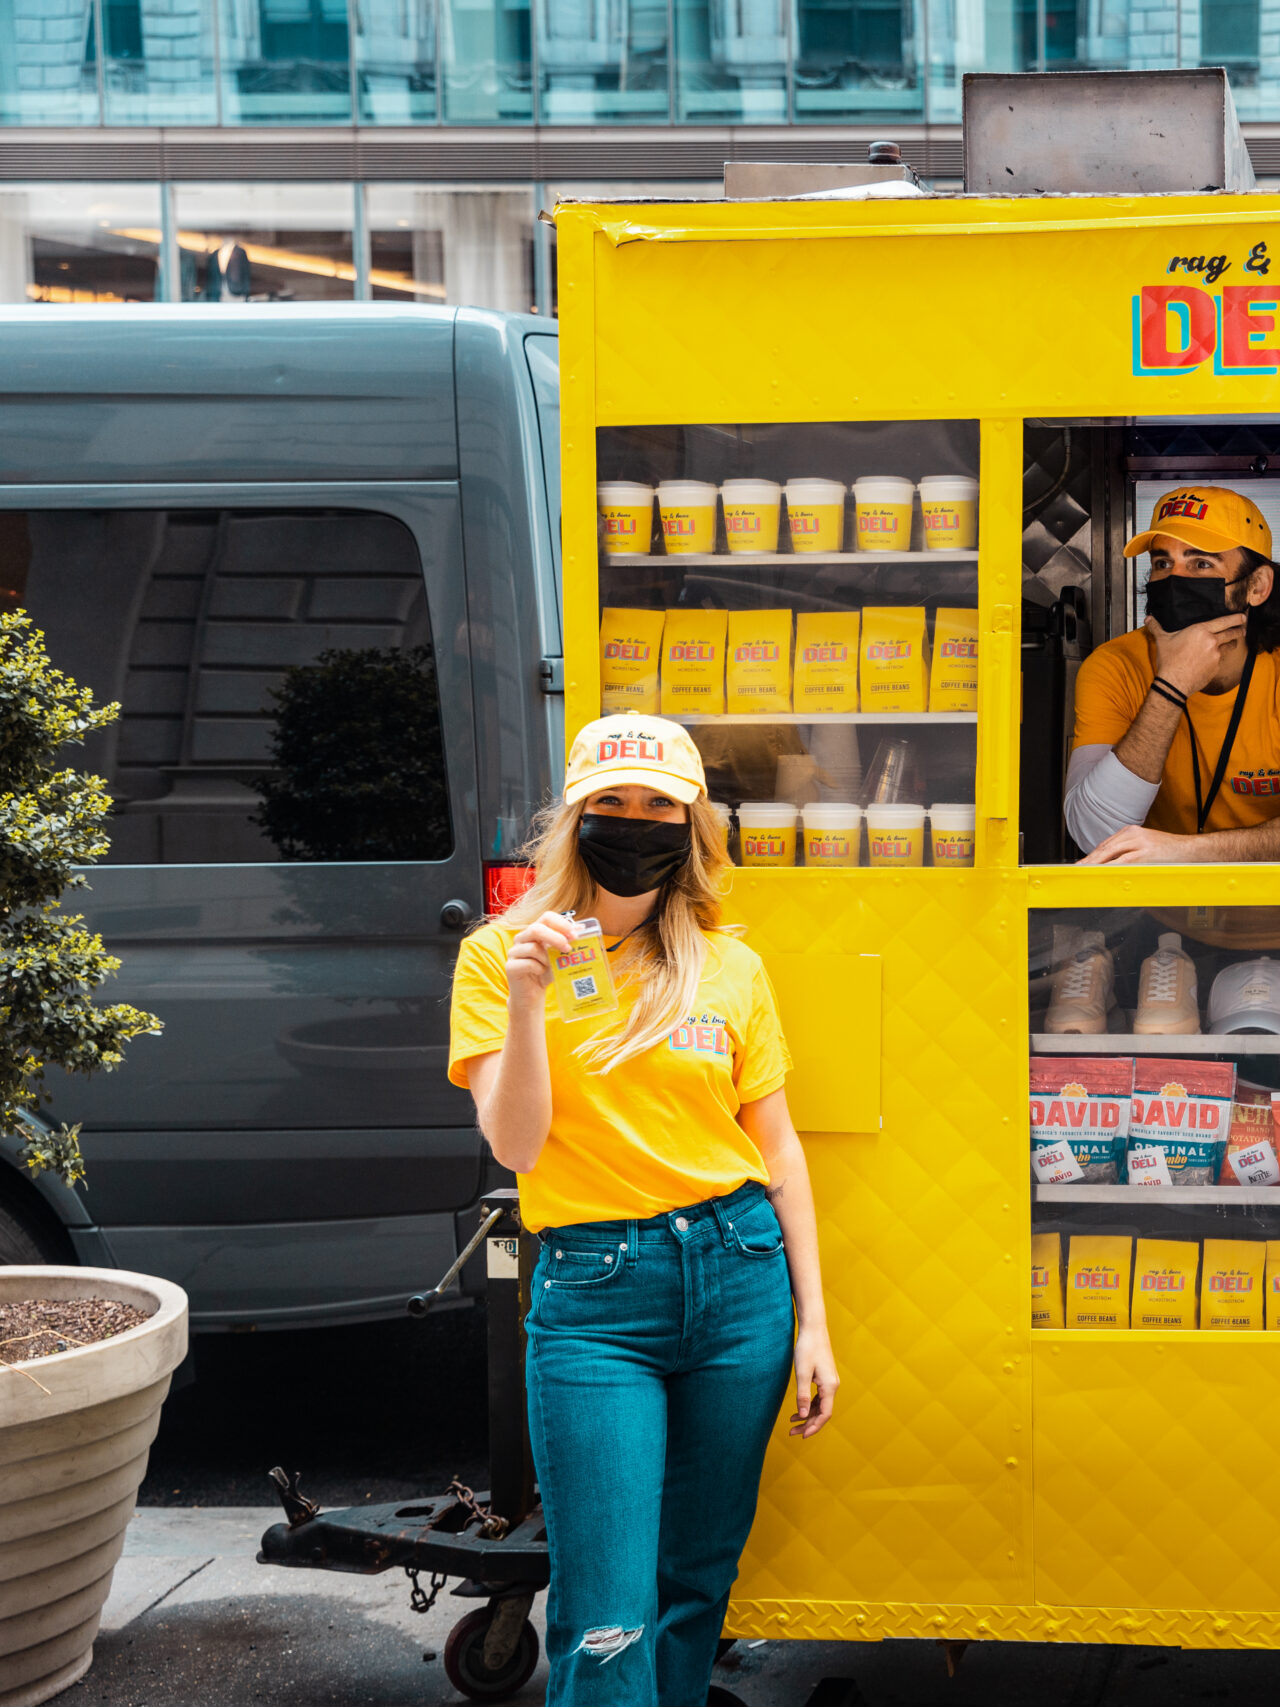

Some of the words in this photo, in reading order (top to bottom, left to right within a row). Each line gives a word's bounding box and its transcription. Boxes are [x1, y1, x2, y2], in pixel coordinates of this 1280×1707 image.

[1167, 254, 1232, 285] rag
[1244, 241, 1271, 276] &
[1158, 500, 1208, 521] DELI
[604, 520, 636, 534] ELI
[860, 517, 898, 533] DELI
[604, 643, 650, 661] DELI
[669, 645, 715, 662] DELI
[735, 646, 779, 663] DELI
[803, 647, 848, 663] DELI
[867, 644, 912, 660] DELI
[941, 643, 978, 659] DEL
[672, 686, 690, 694] COFFEE
[805, 686, 824, 694] COFFEE
[826, 685, 844, 693] BEANS
[871, 684, 890, 692] COFFEE
[892, 683, 910, 691] BEANS
[597, 740, 664, 764] DELI
[1257, 768, 1265, 777] &
[745, 841, 785, 857] DELI
[809, 841, 850, 858] DELI
[872, 841, 912, 858] DELI
[556, 948, 596, 970] DELI
[701, 1014, 708, 1024] &
[1030, 1100, 1120, 1128] DAVID
[1131, 1098, 1220, 1129] DAVID
[1039, 1151, 1065, 1167] DELI
[1131, 1159, 1157, 1170] DELI
[1239, 1151, 1265, 1168] DELI
[1050, 1170, 1073, 1183] DAVID
[1075, 1272, 1120, 1290] DELI
[1141, 1275, 1185, 1292] DELI
[1209, 1276, 1253, 1292] DELI
[1142, 1316, 1162, 1324] COFFEE
